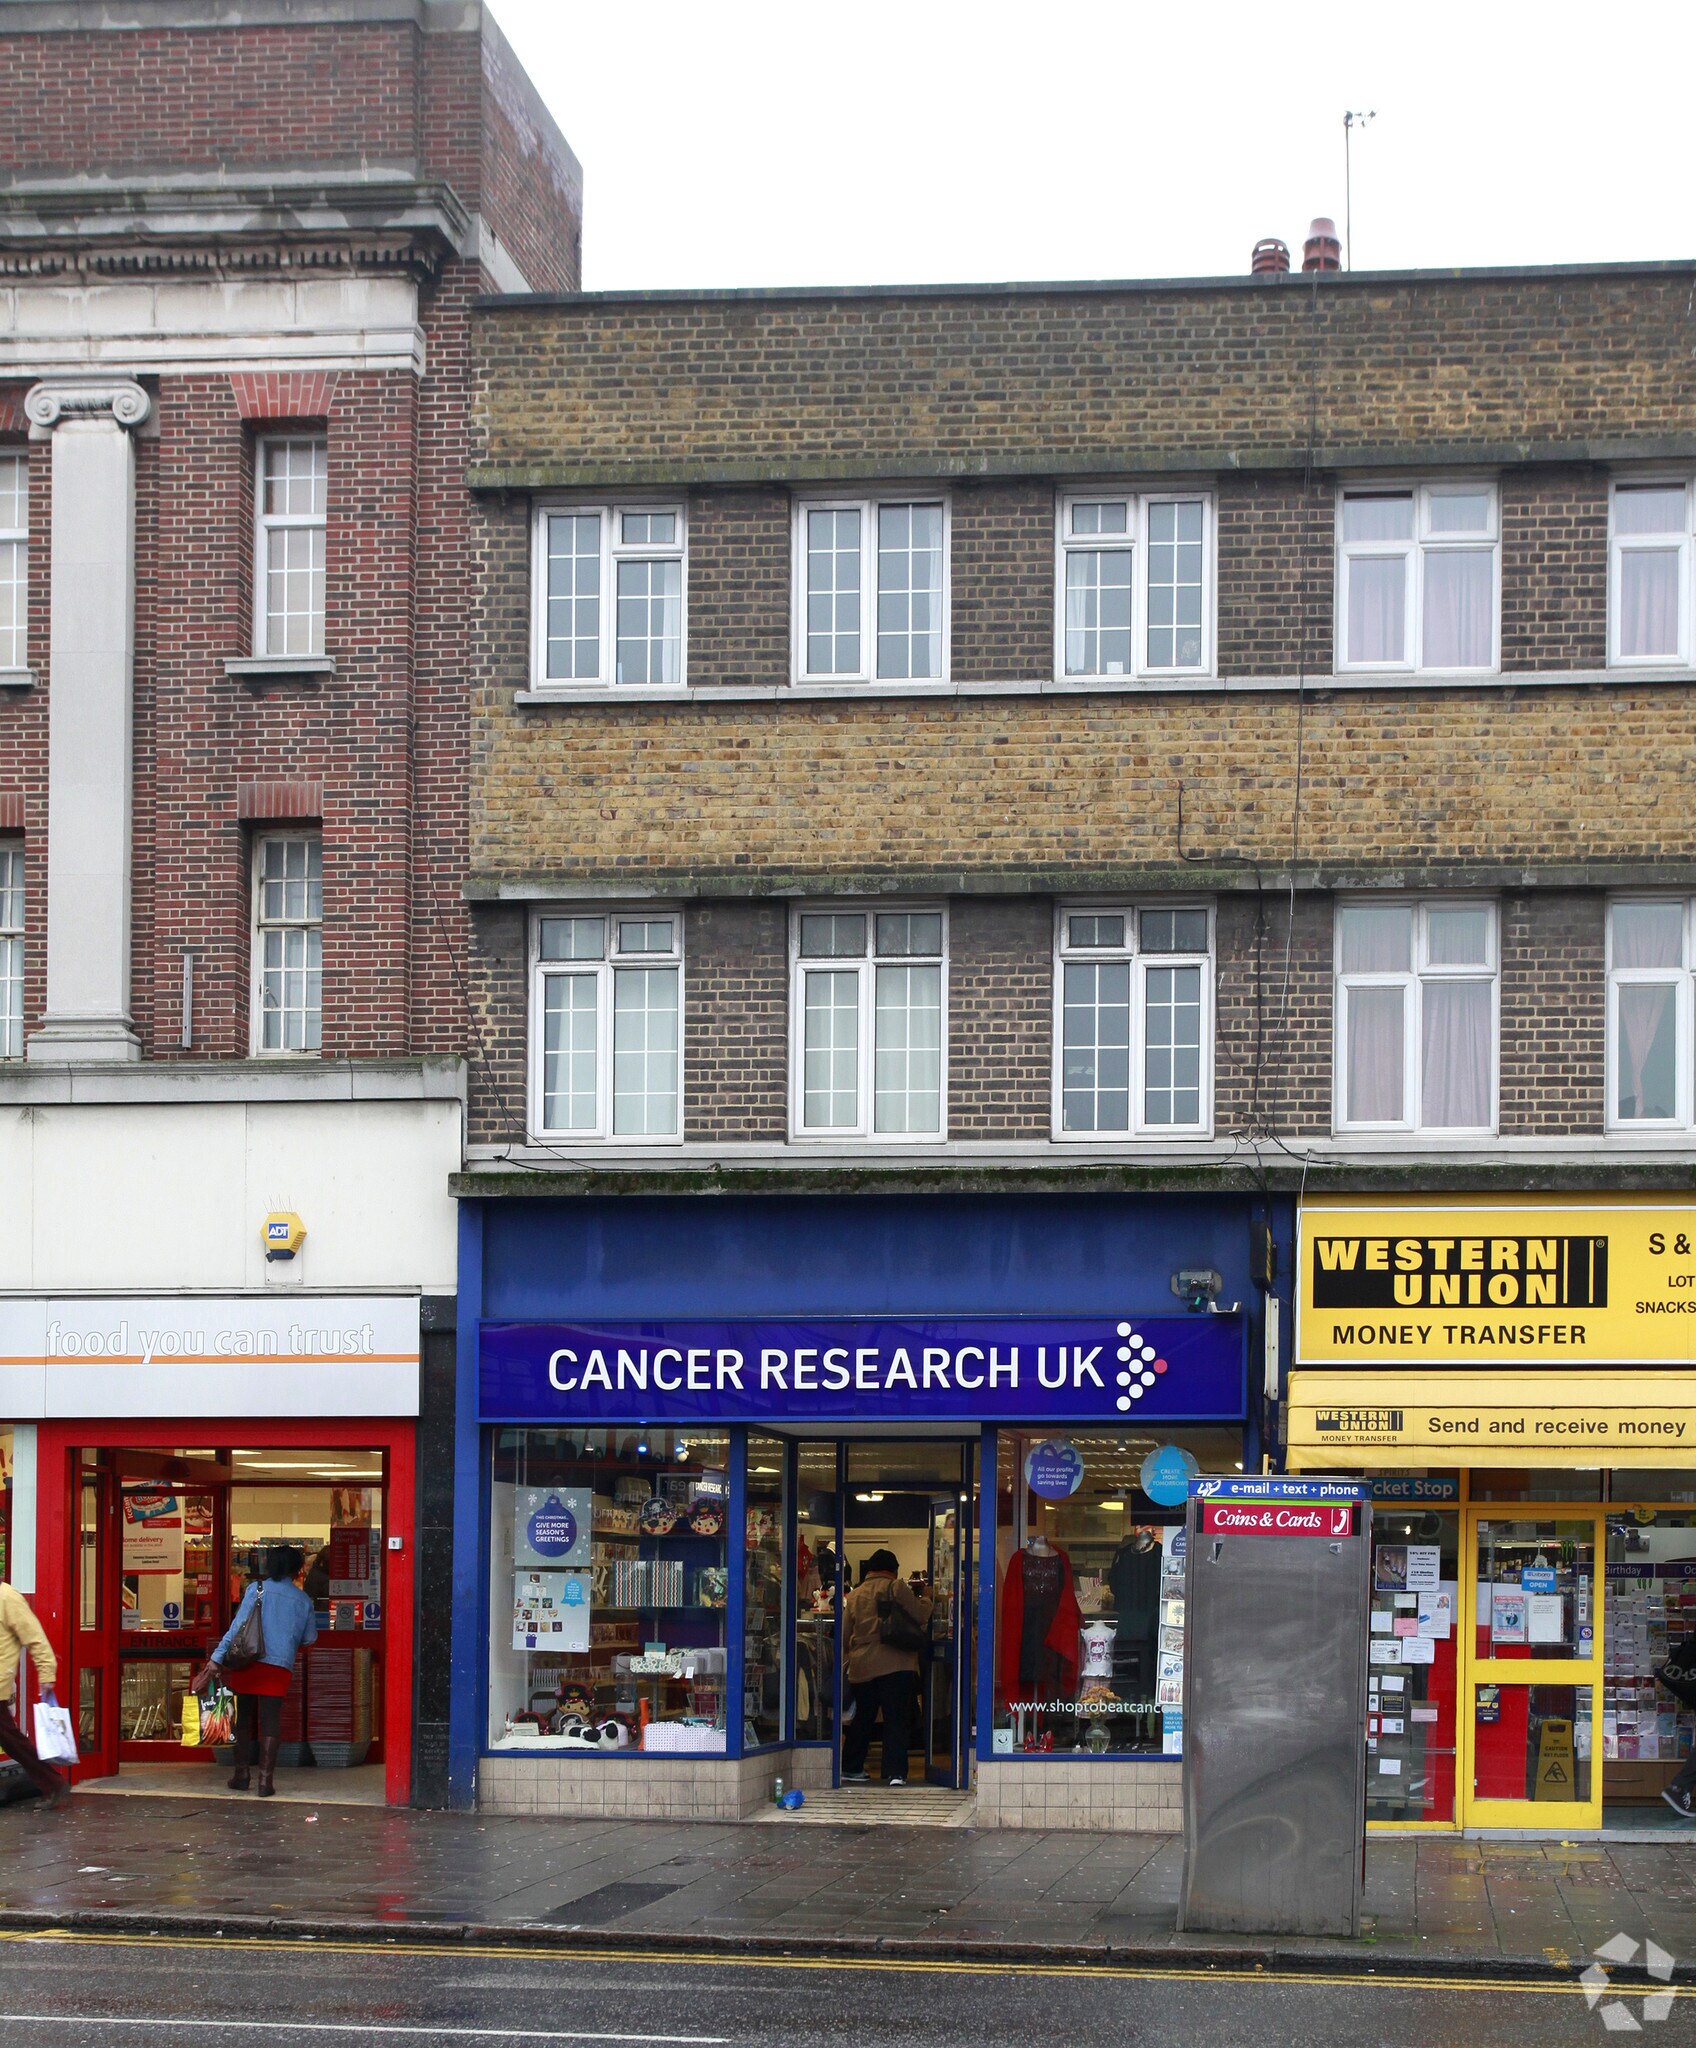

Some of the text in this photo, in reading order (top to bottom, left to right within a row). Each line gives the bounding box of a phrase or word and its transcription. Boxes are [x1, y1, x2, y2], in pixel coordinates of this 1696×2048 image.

[269, 1226, 289, 1237] ADT
[1648, 1233, 1692, 1255] S &
[1317, 1239, 1557, 1271] WESTERN
[1393, 1273, 1557, 1305] UNION
[47, 1321, 374, 1365] food you can trust
[1333, 1324, 1586, 1345] MONEY TRANSFER
[549, 1346, 1105, 1391] CANCER RESEARCH UK
[1317, 1411, 1389, 1421] WESTERN
[1339, 1421, 1389, 1431] UNION
[1428, 1417, 1686, 1438] Send and receive money
[1321, 1435, 1352, 1443] MONEY
[1231, 1483, 1270, 1494] e-mail
[1283, 1484, 1308, 1495] text
[1320, 1484, 1359, 1496] phone
[1414, 1480, 1453, 1499] Stop
[1214, 1509, 1322, 1528] Coins & Cards
[1605, 1565, 1641, 1576] Birthday
[130, 1635, 199, 1648] ENTRANCE
